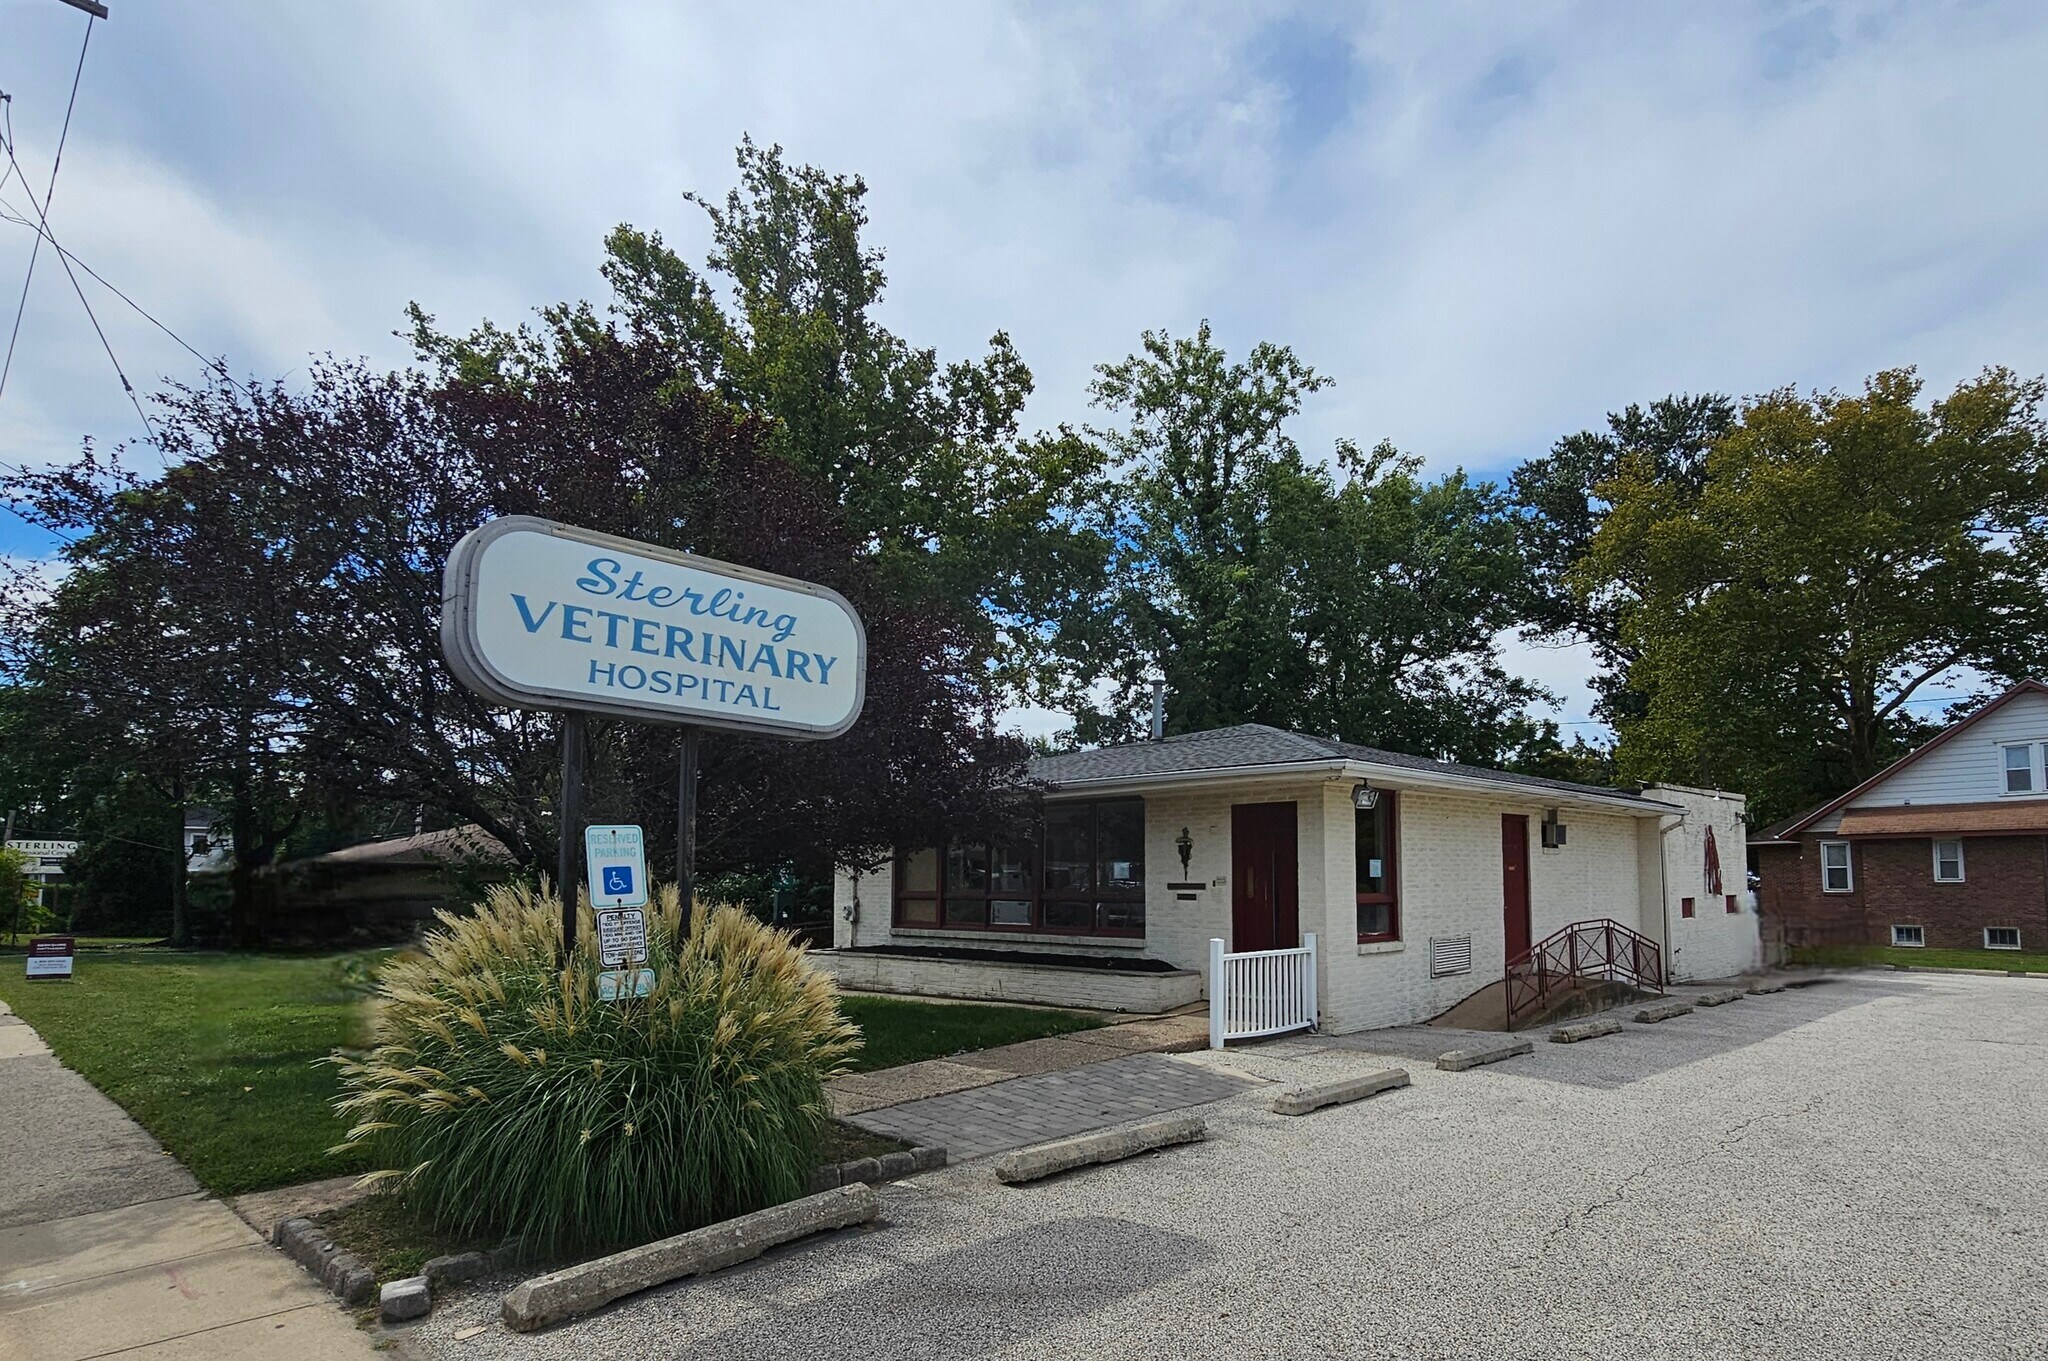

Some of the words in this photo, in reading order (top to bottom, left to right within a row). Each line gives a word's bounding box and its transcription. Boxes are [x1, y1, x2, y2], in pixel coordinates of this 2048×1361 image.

[576, 558, 798, 642] Sterling
[511, 593, 838, 685] VETERINARY
[588, 660, 781, 711] HOSPITAL
[7, 841, 77, 850] STERLING
[591, 833, 639, 845] RESERVED
[594, 847, 637, 858] PARKING
